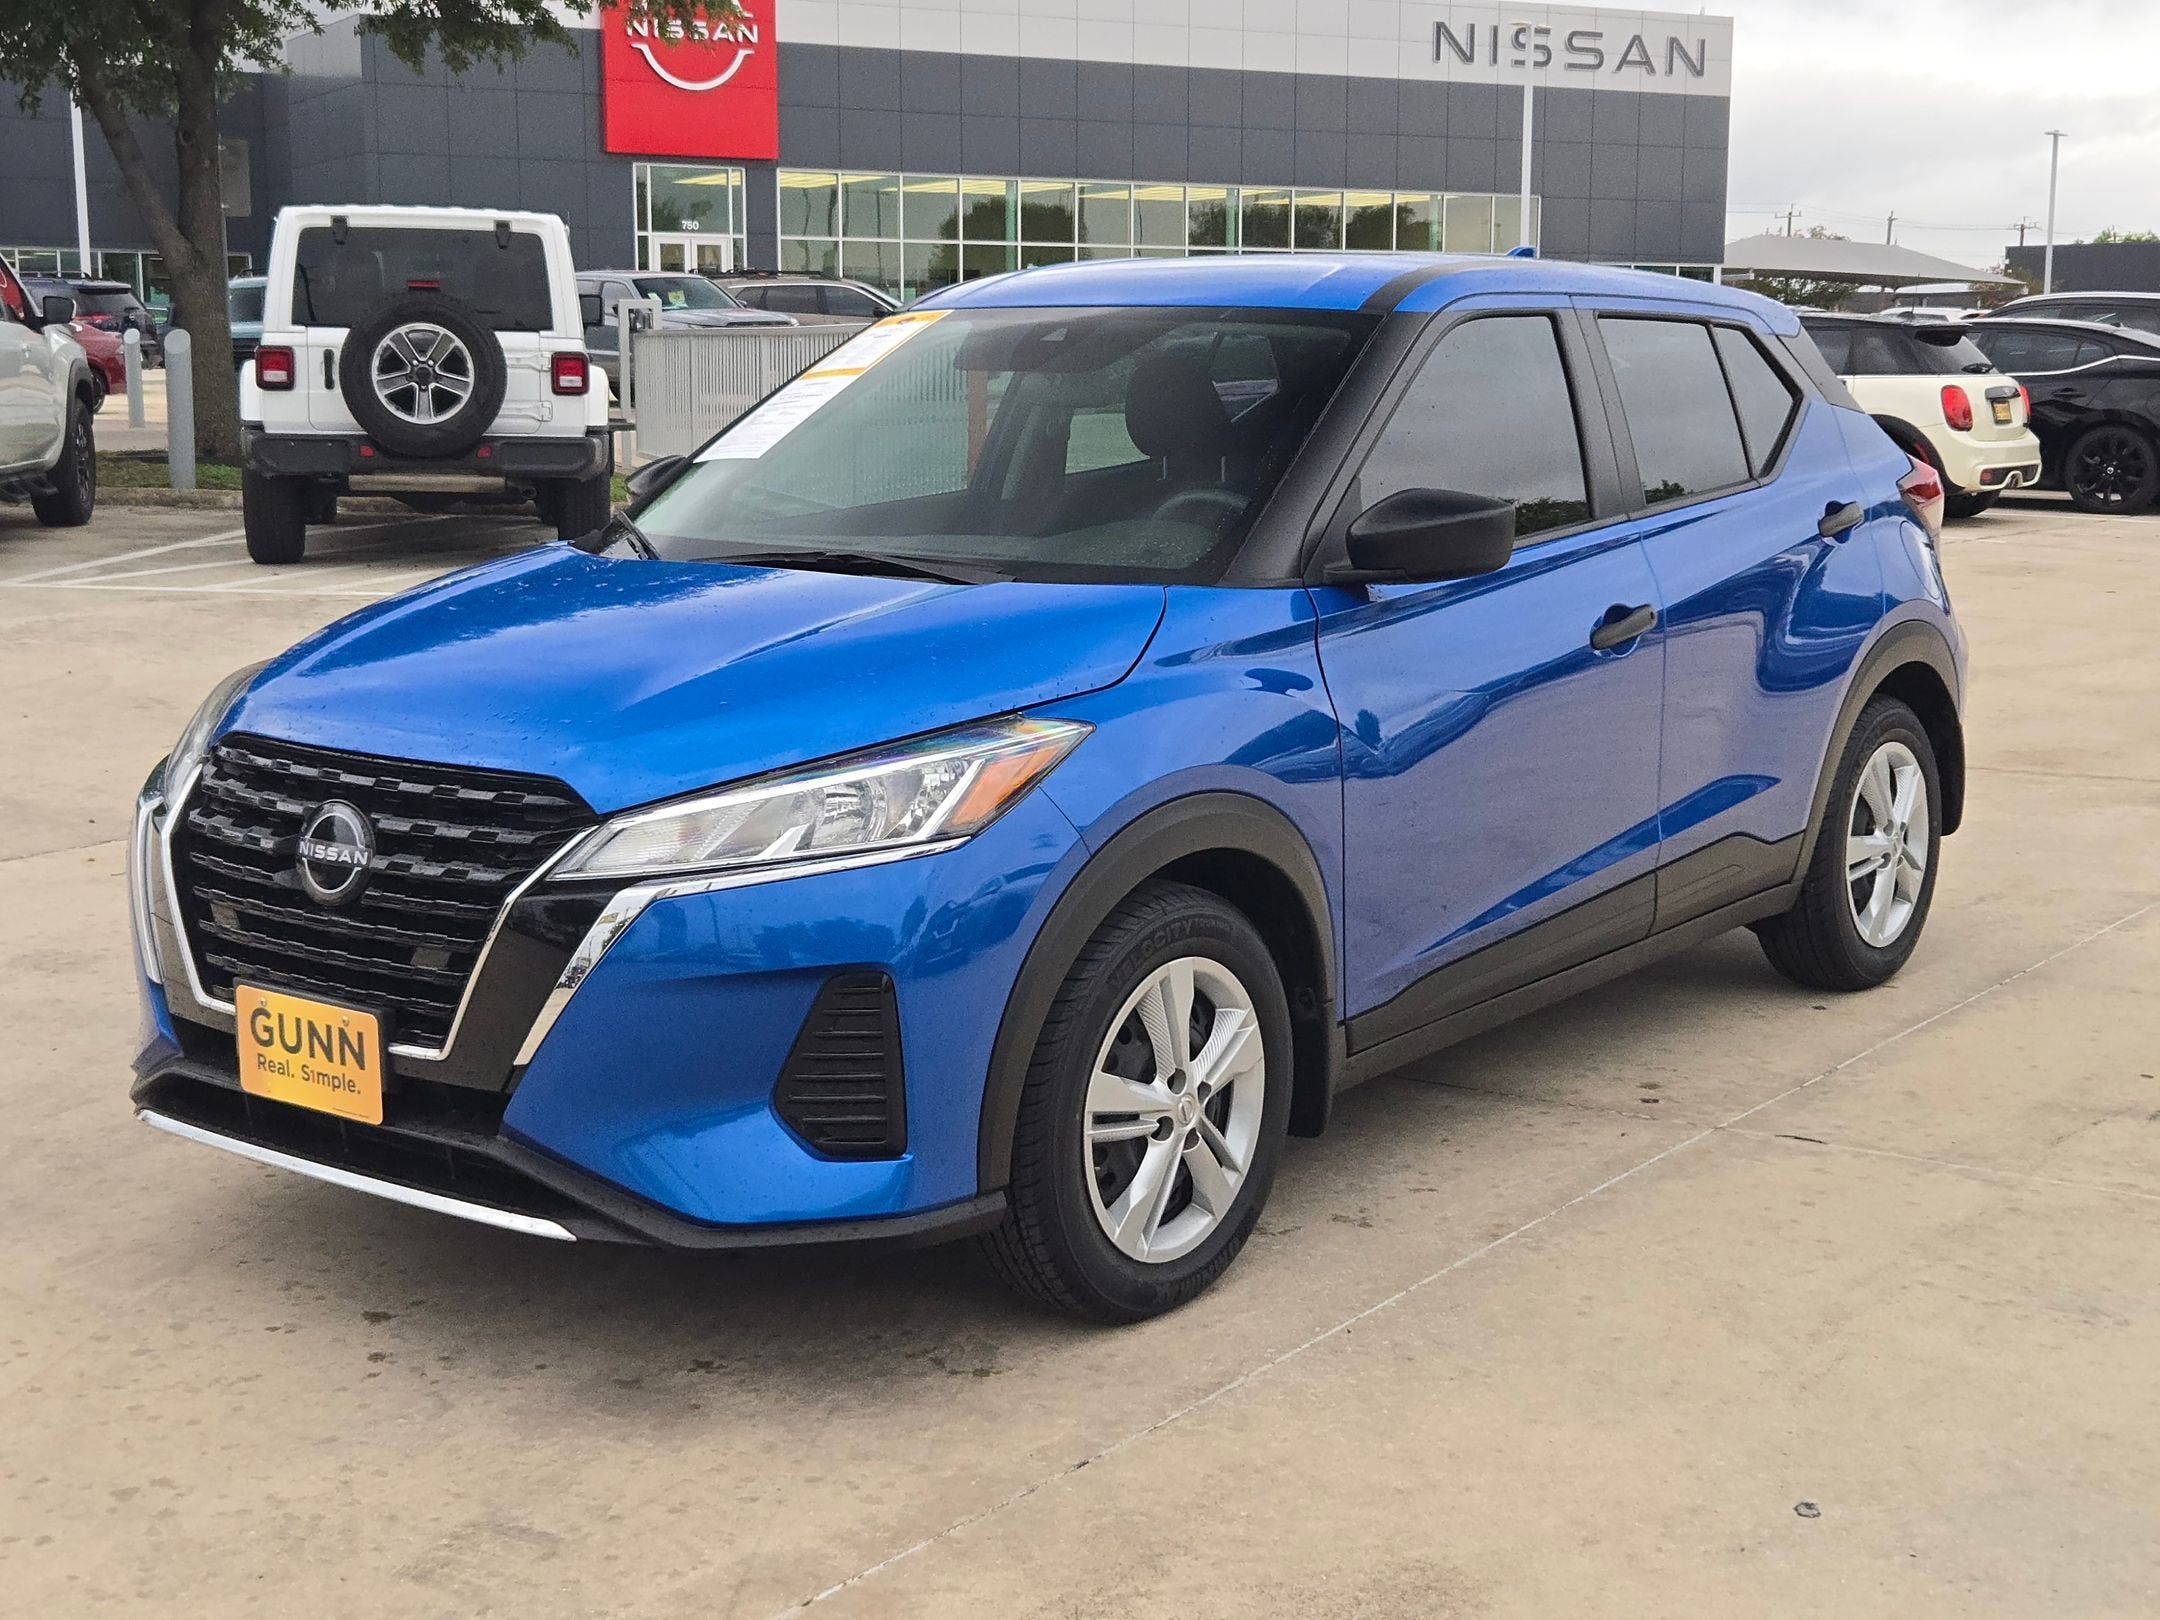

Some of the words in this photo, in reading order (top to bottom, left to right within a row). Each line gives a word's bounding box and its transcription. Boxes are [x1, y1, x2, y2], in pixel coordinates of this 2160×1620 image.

[626, 18, 759, 44] NISSAN
[1432, 20, 1706, 78] NISSAN
[681, 219, 700, 231] 750
[299, 840, 368, 866] NISSAN
[250, 1007, 366, 1071] GUNN
[257, 1053, 295, 1079] Real.
